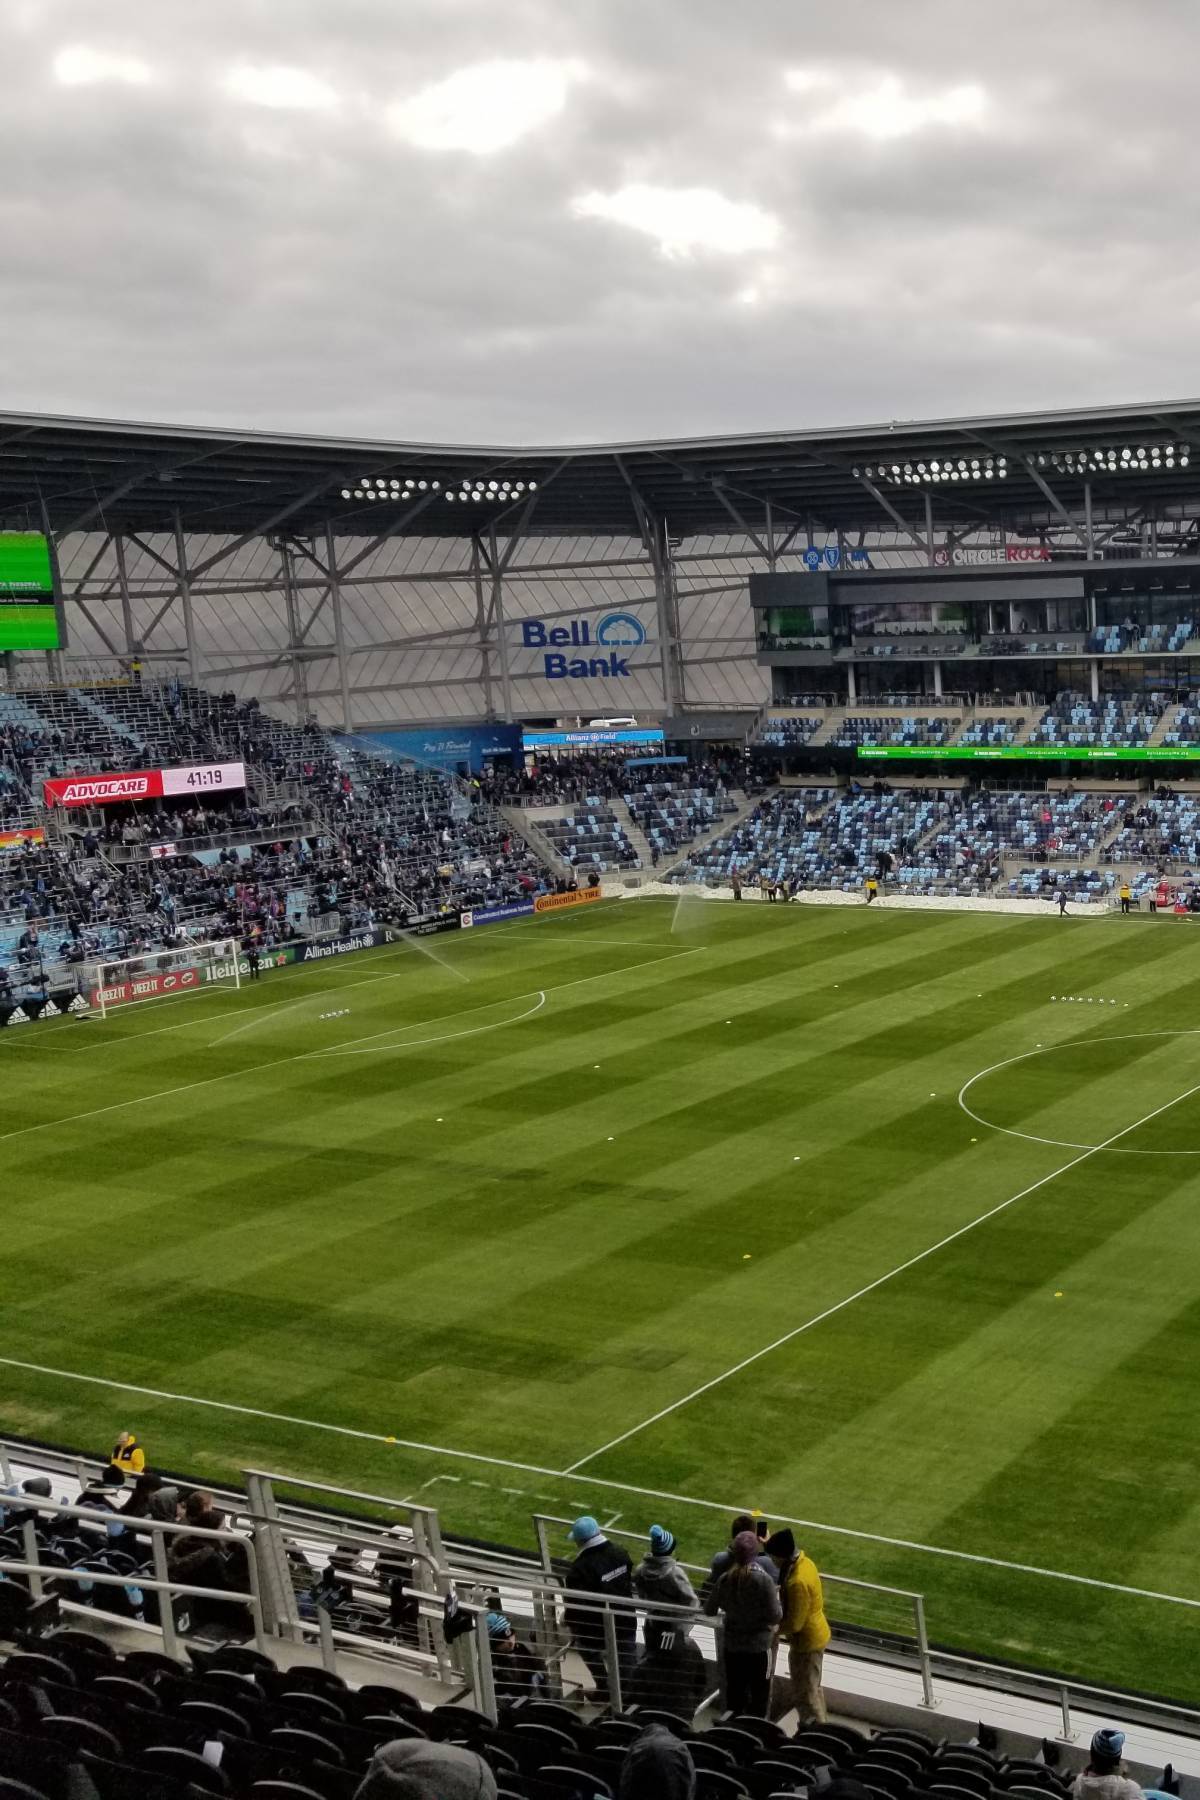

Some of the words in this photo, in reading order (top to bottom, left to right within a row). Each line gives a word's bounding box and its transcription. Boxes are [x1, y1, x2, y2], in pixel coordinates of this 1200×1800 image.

[521, 620, 590, 648] Bell
[544, 652, 632, 679] Bank
[62, 777, 149, 802] ADVOCARE
[186, 769, 223, 787] 41:19
[536, 892, 577, 911] Continental
[304, 940, 332, 960] Allina
[332, 936, 363, 956] Health
[205, 957, 275, 981] Heineen
